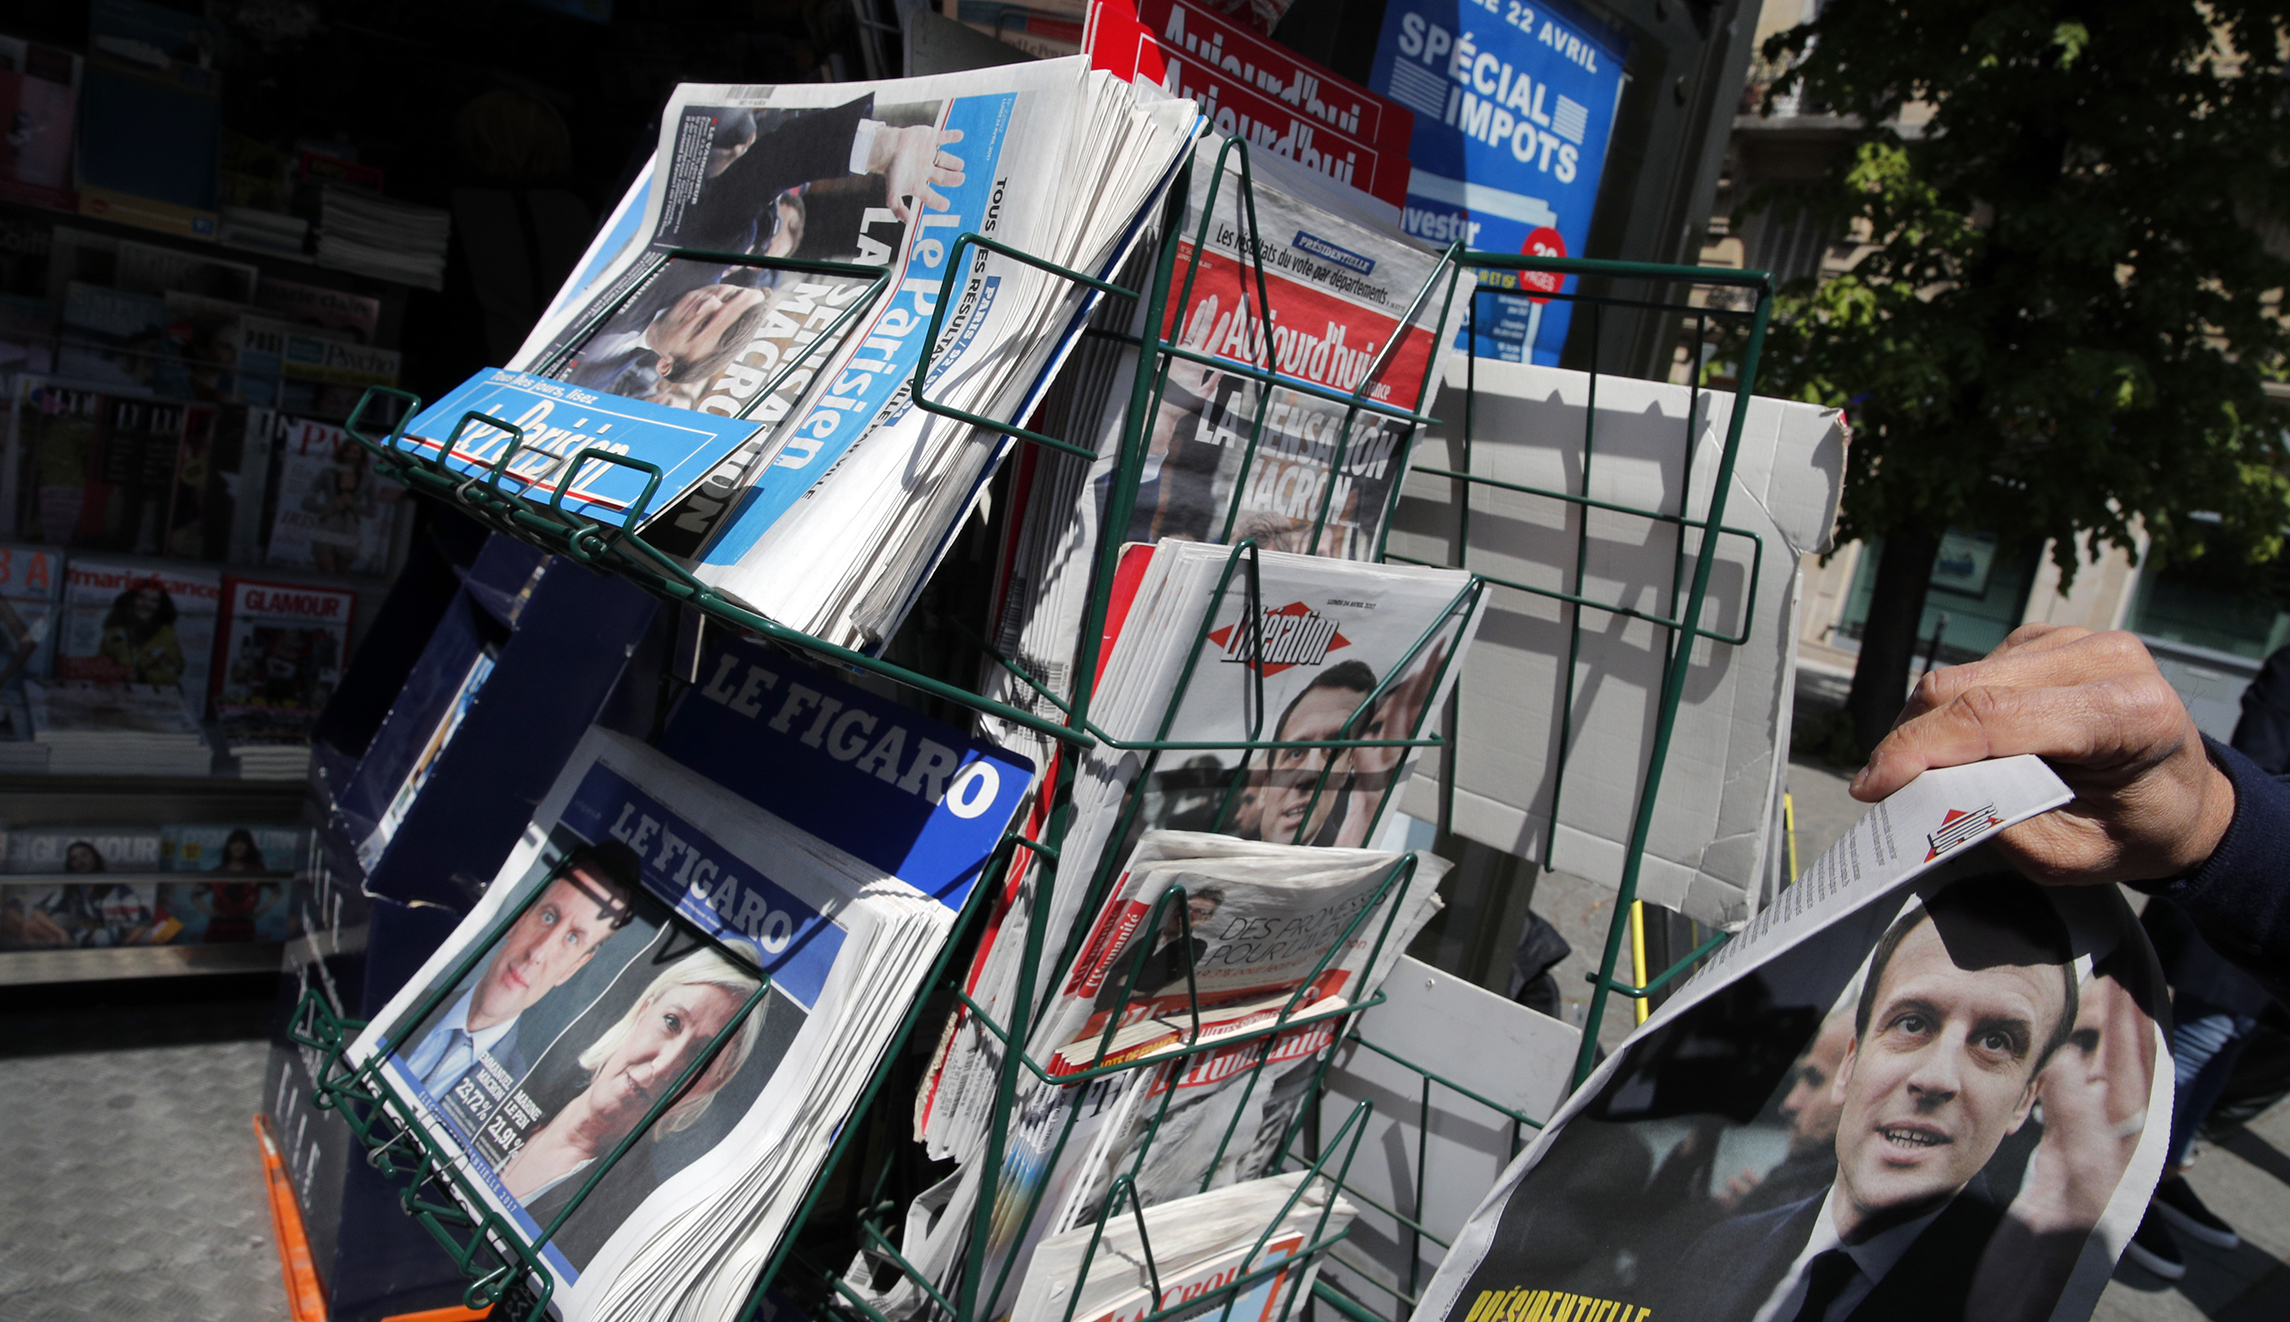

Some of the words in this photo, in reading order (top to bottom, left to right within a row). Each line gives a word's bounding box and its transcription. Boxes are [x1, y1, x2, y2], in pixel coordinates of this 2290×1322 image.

[1505, 1, 1534, 33] 22
[1538, 21, 1597, 74] AVRIL
[1398, 12, 1551, 128] SPÉCIAL
[1445, 85, 1579, 184] IMPOTS
[985, 177, 1008, 232] TOUS
[851, 207, 900, 266] LA
[912, 214, 962, 268] Le
[975, 240, 993, 274] ES
[1298, 235, 1372, 273] PRÉSIDENTIELLE
[1216, 223, 1233, 247] Les
[1277, 248, 1291, 268] du
[1292, 256, 1314, 276] vote
[1312, 266, 1330, 285] par
[1329, 269, 1388, 305] départements
[1523, 270, 1555, 292] PAGES
[929, 279, 982, 366] RÉSULTAT
[964, 286, 996, 342] PARIS
[1221, 291, 1375, 391] Aujourd'hui
[698, 282, 836, 420] MACRO
[773, 277, 956, 471] Parisien
[941, 349, 960, 369] 92
[489, 371, 514, 384] Tous
[532, 379, 566, 398] jours,
[565, 388, 600, 405] lisez
[877, 377, 916, 421] VILLE
[1362, 379, 1391, 401] rance
[471, 399, 630, 493] Parisien
[849, 423, 880, 454] PAR
[1194, 390, 1244, 449] LA
[1246, 401, 1399, 480] ENSAION
[801, 457, 848, 500] VILLE
[244, 589, 340, 618] GLAMOUR
[700, 653, 779, 719] LE
[768, 684, 1001, 820] FIGARO
[31, 834, 160, 863] GLOUR
[608, 801, 660, 858] LE
[651, 820, 793, 954] FIGARO
[1086, 911, 1142, 990] l'Humanité
[1205, 942, 1282, 966] POUR
[1219, 917, 1281, 942] DES
[1199, 1021, 1239, 1039] LUTTES
[475, 1068, 506, 1102] MACRON
[478, 1051, 514, 1091] EMMANUEL
[503, 1100, 518, 1117] LE
[511, 1108, 531, 1131] PEN
[513, 1089, 543, 1122] MARINE
[448, 1128, 501, 1191] DENTIELLE
[499, 1191, 518, 1214] 2017
